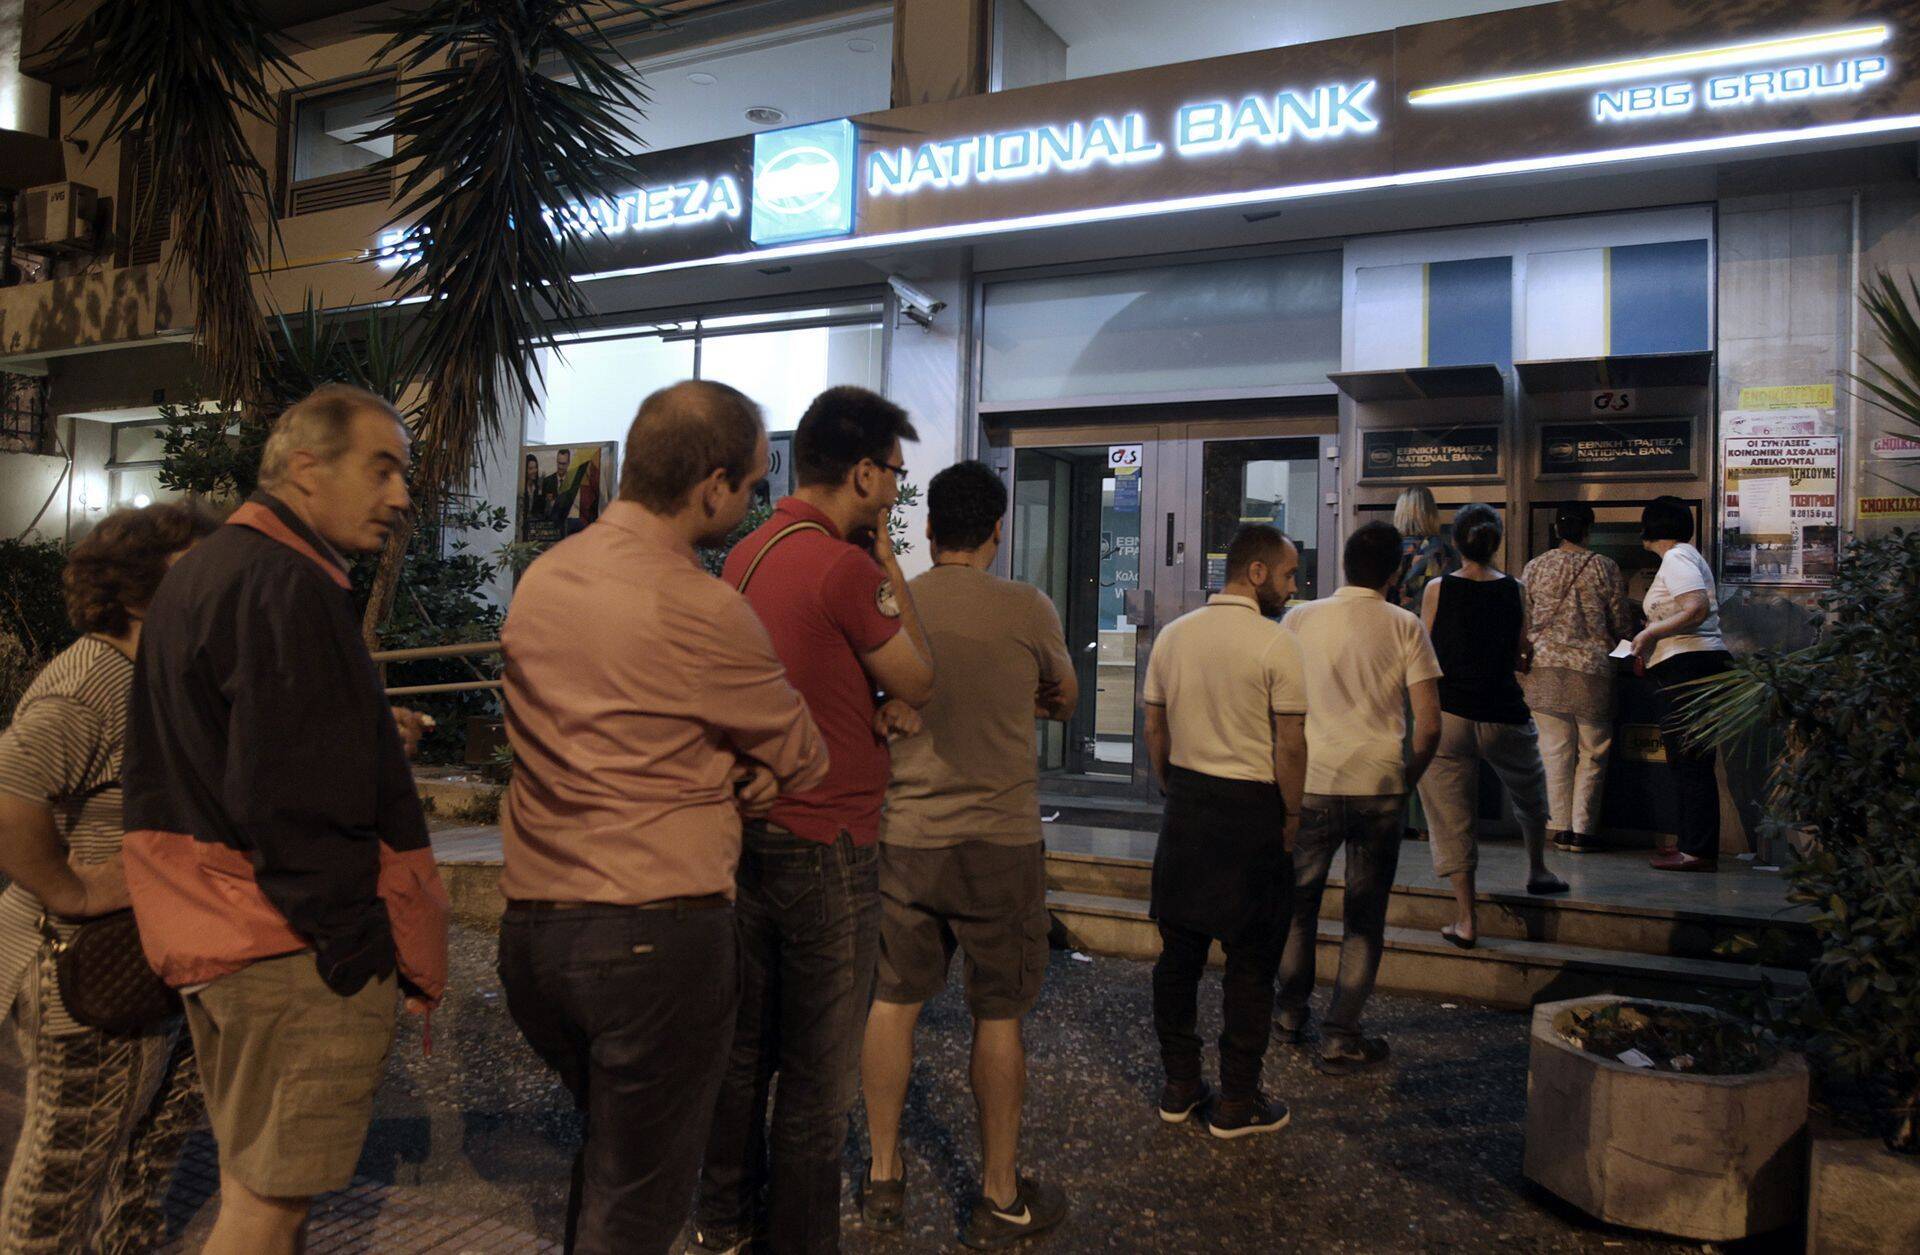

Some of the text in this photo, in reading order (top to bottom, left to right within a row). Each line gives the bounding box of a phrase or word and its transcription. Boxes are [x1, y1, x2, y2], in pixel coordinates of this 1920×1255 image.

[1595, 56, 1887, 118] NBG GROUP
[867, 80, 1378, 194] NATIONAL BANK
[1578, 438, 1683, 449] ΕΘΝΙΚΗ ΤΡΑΠΕΖΑ
[1747, 440, 1758, 448] ΟΙ
[1111, 449, 1137, 465] G4S
[1578, 447, 1673, 457] NATIONAL BANK
[1728, 448, 1836, 457] ΚΟΙΝΩΝΙΚΗ ΑΣΦΑΛΙΣΗ
[1396, 453, 1483, 463] NATIONAL BANK
[1751, 458, 1815, 466] ΑΠΕΙΛΟΥΝΤΑΙ
[1797, 509, 1815, 518] 2015
